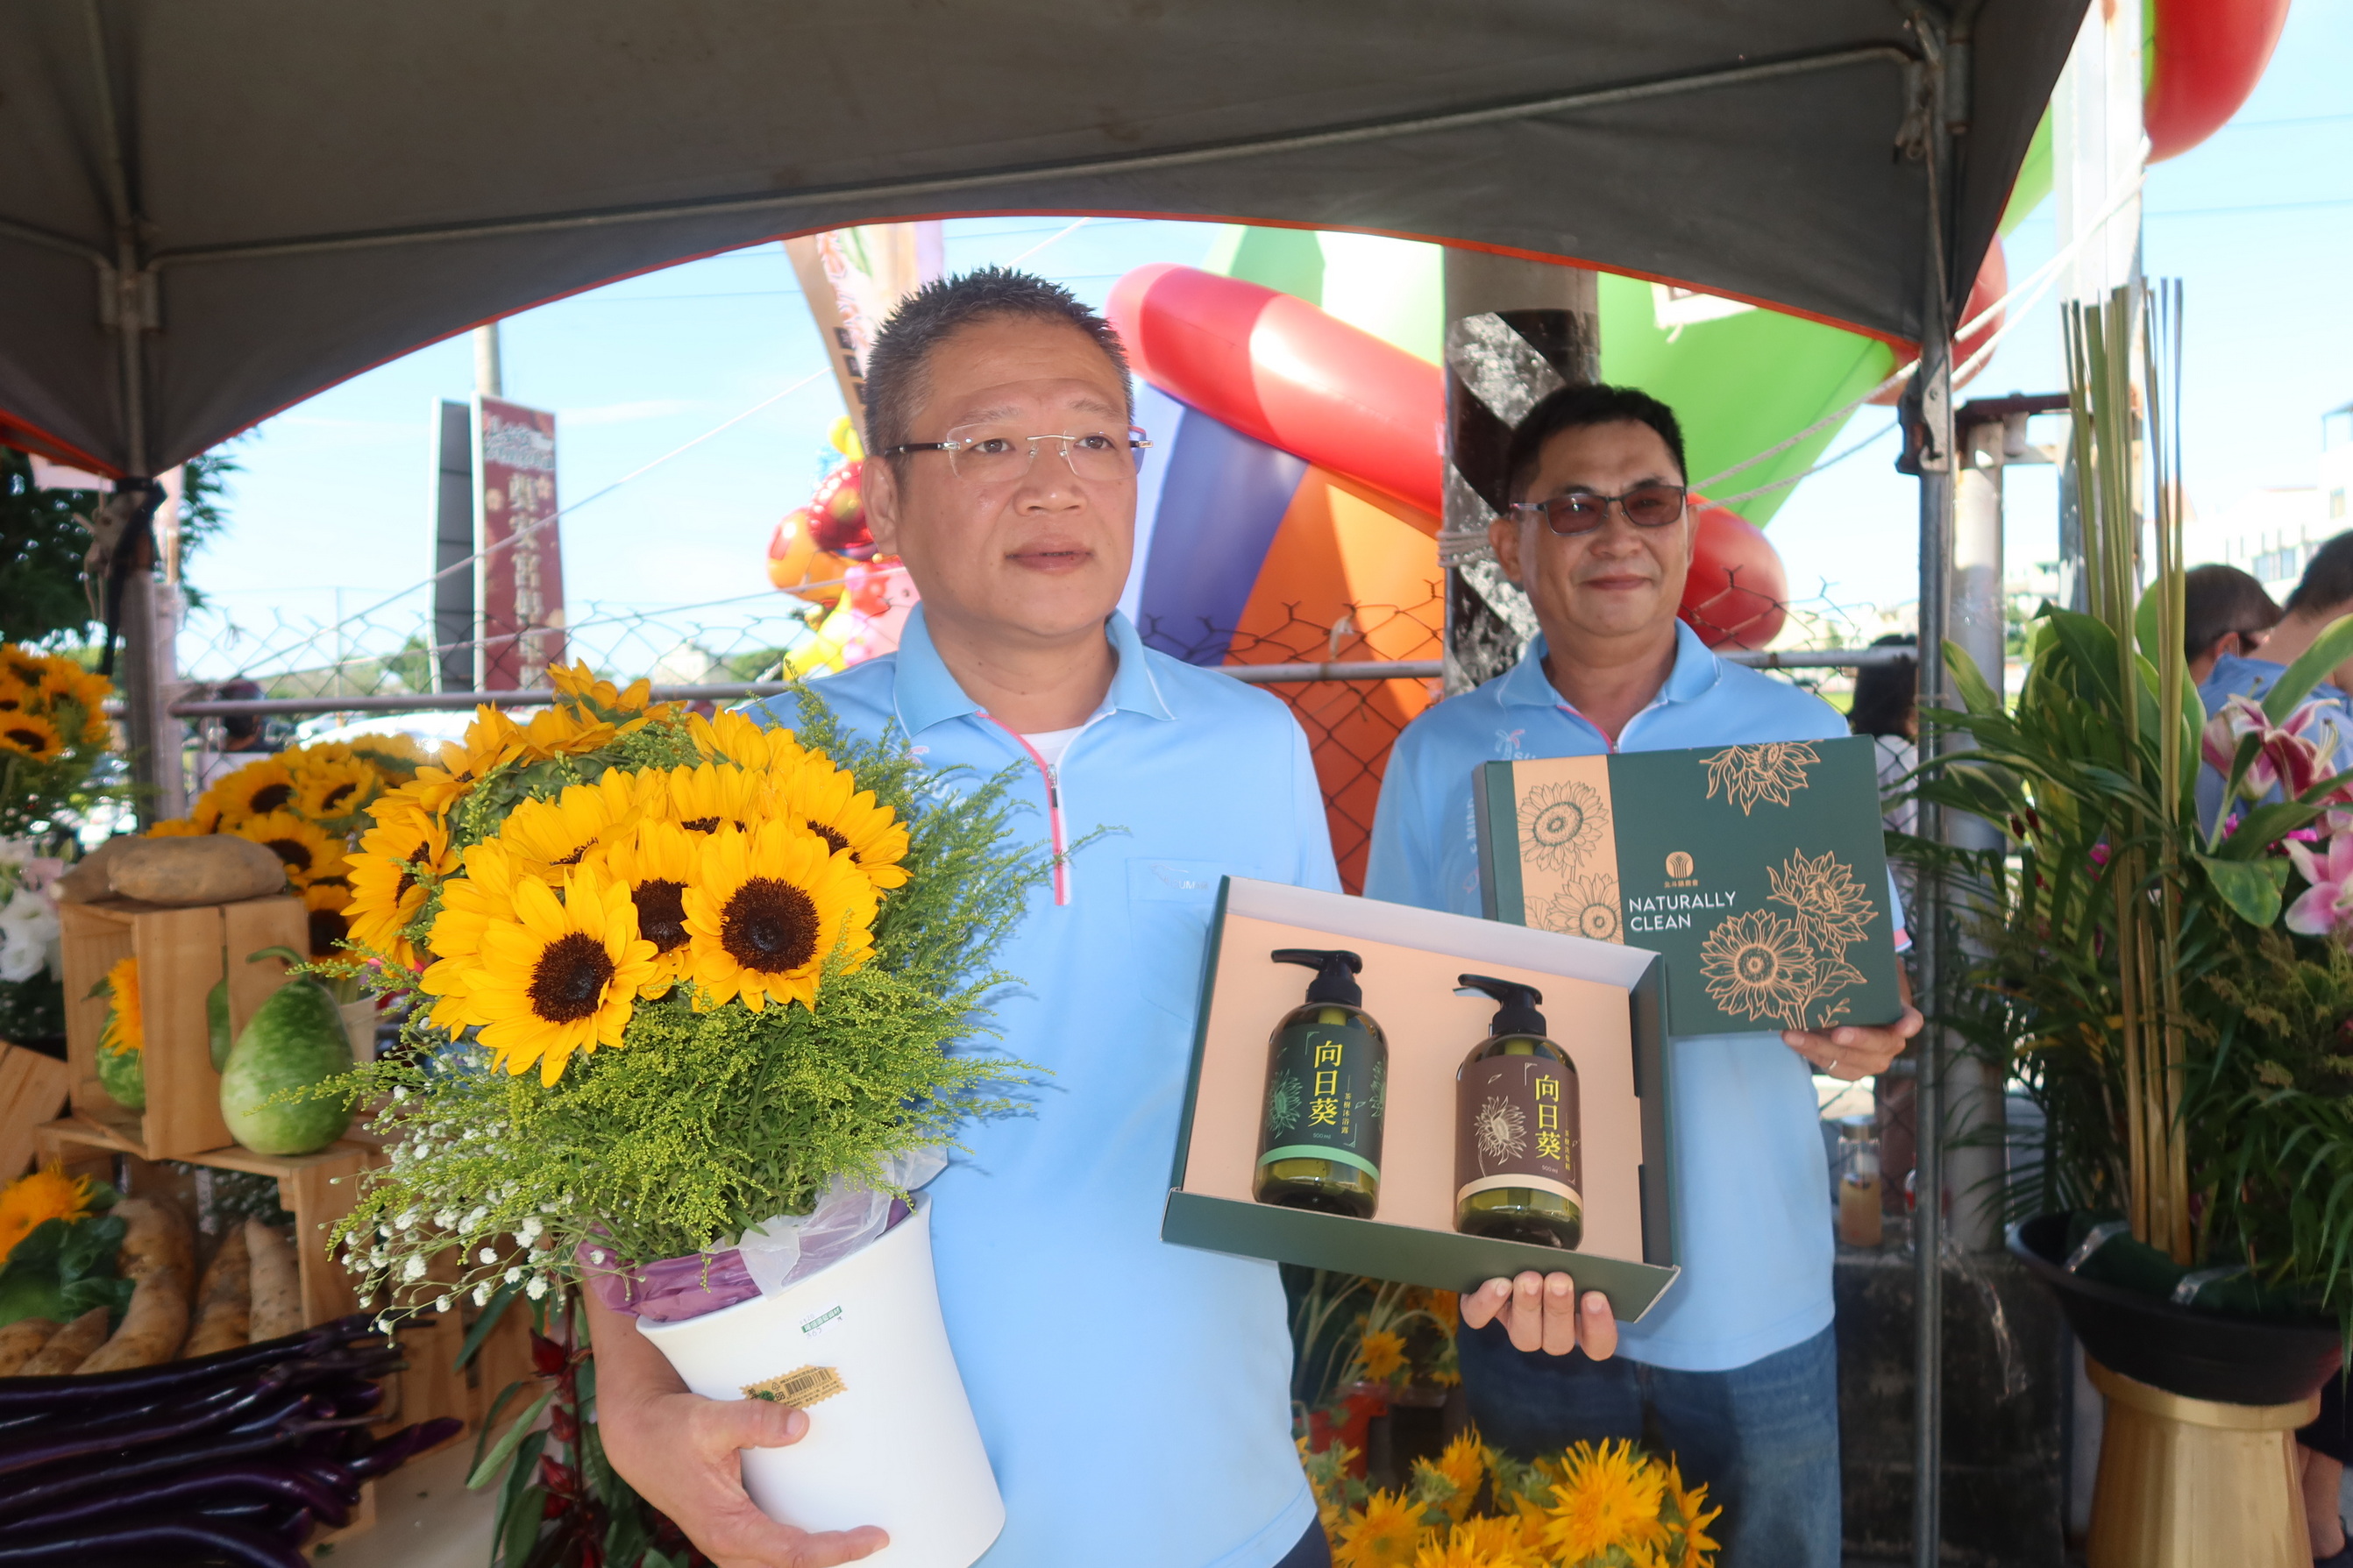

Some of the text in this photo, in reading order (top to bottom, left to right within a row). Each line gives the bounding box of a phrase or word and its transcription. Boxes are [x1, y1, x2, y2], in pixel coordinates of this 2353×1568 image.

[1629, 890, 1736, 912] NATURALLY
[1631, 913, 1691, 931] CLEAN
[1307, 1040, 1343, 1127] 向日葵
[1535, 1074, 1561, 1160] 向日葵
